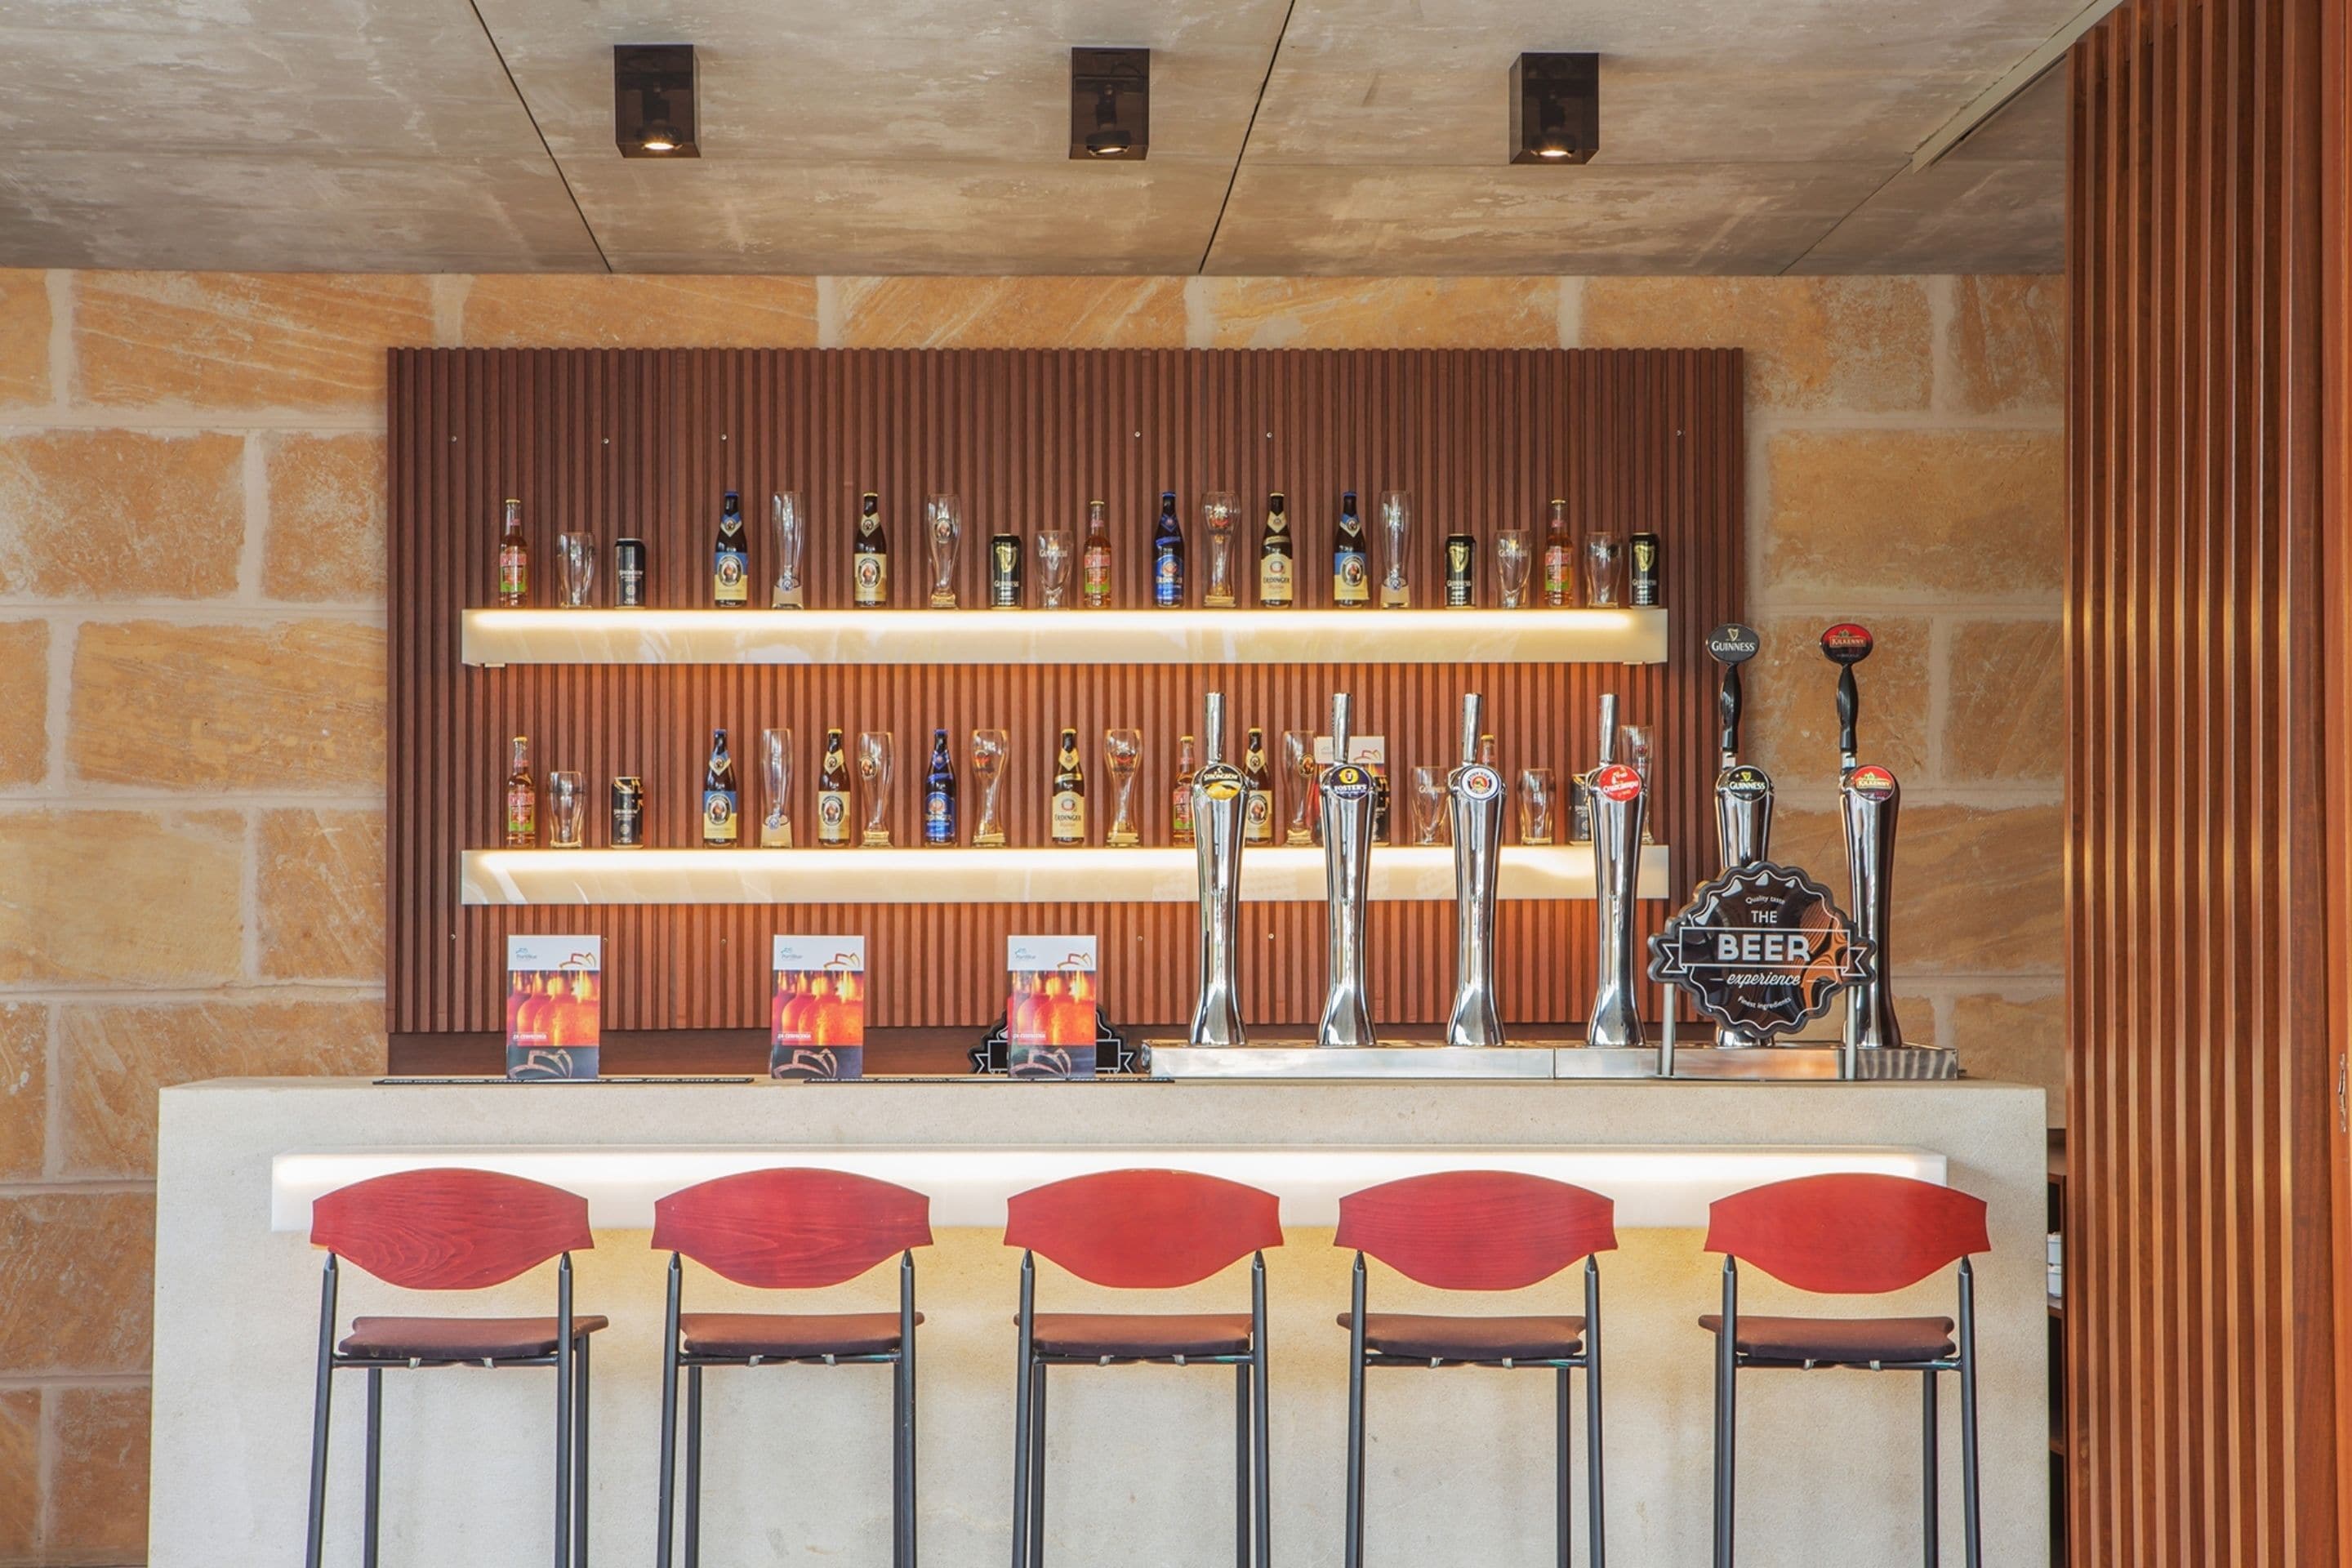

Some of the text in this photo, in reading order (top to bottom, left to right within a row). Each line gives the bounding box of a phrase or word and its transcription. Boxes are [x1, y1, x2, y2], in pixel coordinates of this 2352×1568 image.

[1711, 640, 1756, 653] GUINNESS
[1729, 781, 1766, 791] GUINNESS
[1745, 895, 1769, 905] Quality
[1750, 910, 1778, 924] THE
[1717, 933, 1811, 962] BEER
[1726, 971, 1802, 989] experience
[1737, 995, 1793, 1011] Finest ingredients
